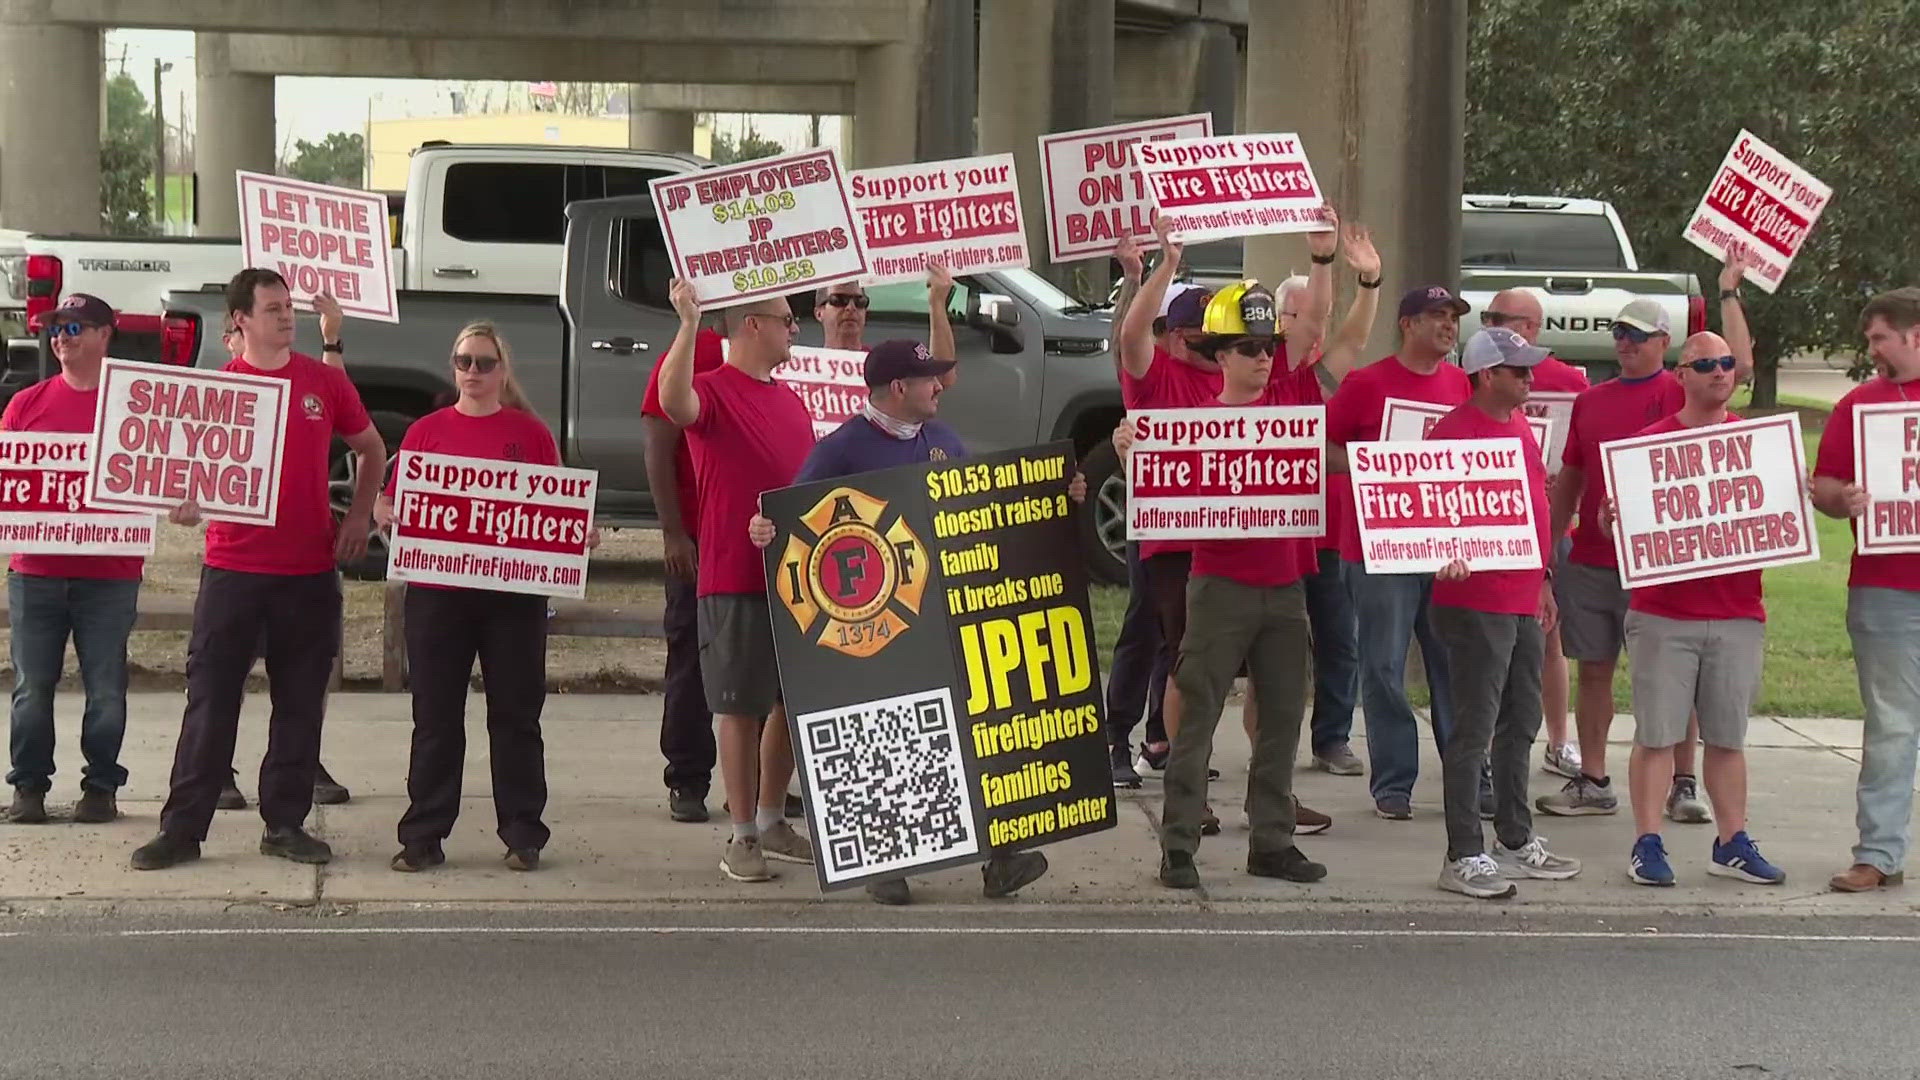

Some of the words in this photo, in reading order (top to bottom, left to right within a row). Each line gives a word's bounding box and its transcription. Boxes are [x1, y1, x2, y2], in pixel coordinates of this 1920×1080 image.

[1141, 141, 1239, 165] Support
[1241, 138, 1295, 161] your
[666, 185, 691, 211] JP
[695, 159, 832, 205] EMPLOYEES
[852, 169, 949, 200] Support
[954, 165, 1009, 193] your
[1078, 175, 1124, 207] ON
[1150, 172, 1206, 200] Fire
[1208, 166, 1311, 201] Fighters
[1733, 138, 1792, 191] Support
[1785, 181, 1824, 211] your
[259, 188, 309, 223] LET
[315, 197, 370, 234] THE
[712, 191, 796, 225] $14.03
[748, 217, 773, 242] JP
[861, 209, 907, 240] Fire
[912, 200, 1015, 238] Fighters
[1170, 207, 1324, 232] effersonFireFighters.com
[1711, 170, 1747, 212] Fire
[1742, 188, 1806, 250] Fighters
[78, 259, 171, 272] TREMOR
[261, 223, 374, 268] PEOPLE
[685, 227, 849, 279] FIREFIGHTERS
[278, 261, 361, 301] VOTE!
[732, 259, 816, 293] $10.53
[1243, 307, 1275, 321] 294
[828, 359, 865, 380] you
[127, 379, 258, 428] SHAME
[119, 416, 172, 455] ON
[181, 421, 254, 463] YOU
[1134, 416, 1246, 445] Support
[1255, 417, 1319, 444] your
[0, 441, 87, 464] upport
[1134, 453, 1191, 487] Fire
[1200, 451, 1318, 494] Fighters
[1356, 447, 1454, 477] Support
[1461, 449, 1516, 475] your
[1649, 443, 1705, 483] FAIR
[1708, 434, 1753, 473] PAY
[105, 453, 263, 507] SHENG!
[405, 455, 519, 492] Support
[526, 474, 591, 498] your
[926, 463, 992, 502] $10.53
[994, 463, 1018, 488] an
[1020, 455, 1065, 485] hour
[401, 492, 459, 532] Fire
[467, 498, 586, 545] Fighters
[829, 495, 862, 526] A
[934, 501, 1004, 539] doesn't
[1006, 496, 1053, 527] raise
[1056, 494, 1068, 517] a
[1133, 507, 1319, 530] JeffersonFireFighters.com
[1360, 485, 1414, 519] Fire
[1418, 483, 1525, 526] Fighters
[1652, 484, 1702, 524] FOR
[1708, 474, 1764, 516] JPFD
[940, 542, 999, 577] family
[1370, 537, 1532, 561] JeffersonFireFighters.com
[1631, 511, 1800, 570] FIREFIGHTERS
[394, 547, 581, 586] JeffersonFireFighters.com
[832, 545, 868, 598] F
[894, 540, 915, 585] F
[947, 587, 964, 616] it
[964, 577, 1028, 613] breaks
[1029, 572, 1063, 600] one
[837, 620, 891, 646] 1374
[959, 605, 1092, 716] JPFD
[972, 704, 1099, 759] firefighters
[981, 761, 1071, 808] families
[989, 809, 1055, 847] deserve
[1057, 796, 1108, 830] better
